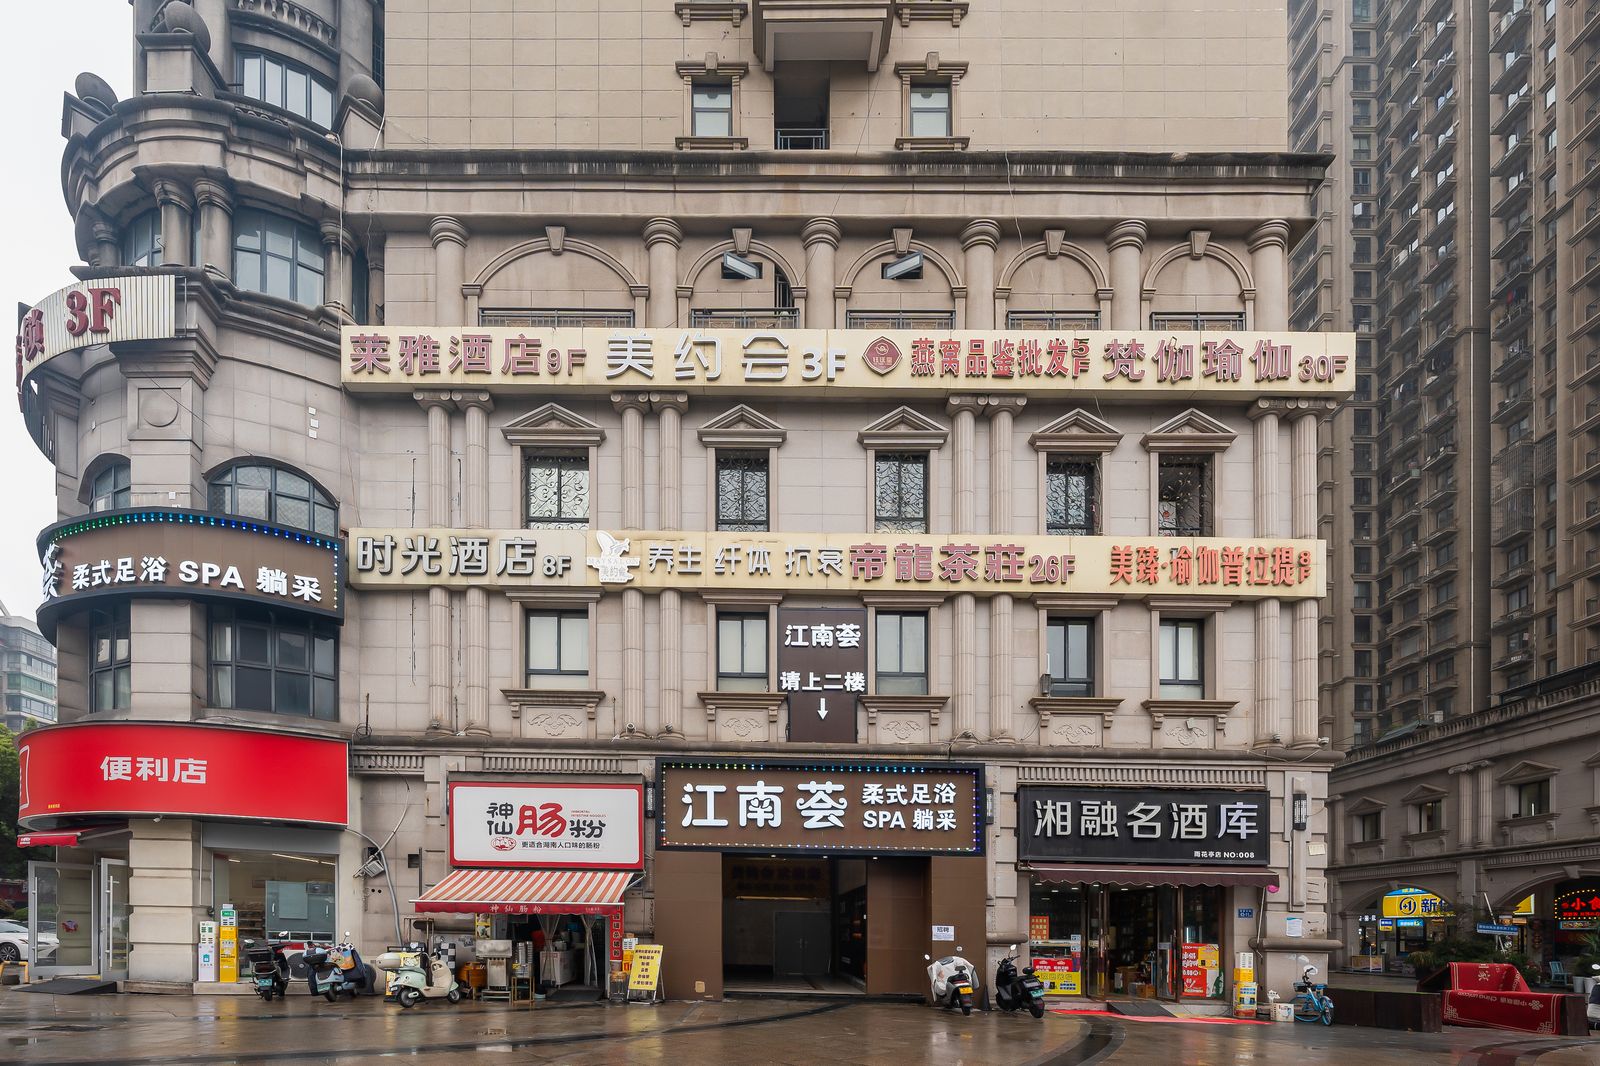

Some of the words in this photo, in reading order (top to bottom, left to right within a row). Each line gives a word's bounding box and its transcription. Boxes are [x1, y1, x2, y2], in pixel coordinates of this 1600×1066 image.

[66, 287, 121, 337] 3F
[349, 333, 587, 377] 莱雅酒店9F
[1103, 336, 1349, 383] 梵伽瑜伽30F
[356, 534, 572, 577] 时光酒店8F
[649, 543, 702, 575] 养生
[714, 543, 772, 577] 纤体
[785, 545, 844, 577] 抗衰
[849, 542, 1076, 584] 帝龍茶莊26F
[72, 555, 168, 590] 柔式足浴
[178, 560, 245, 590] SPA
[256, 566, 323, 602] 躺采
[784, 623, 861, 648] 江南荟
[780, 670, 866, 692] 请上二楼
[99, 755, 208, 785] 便利店
[681, 780, 848, 830] 江南荟
[862, 783, 956, 806] 柔式足浴
[862, 810, 906, 830] SPA
[912, 809, 957, 831] 躺采
[1034, 800, 1259, 841] 湘融名酒库
[1223, 851, 1255, 859] NO:008
